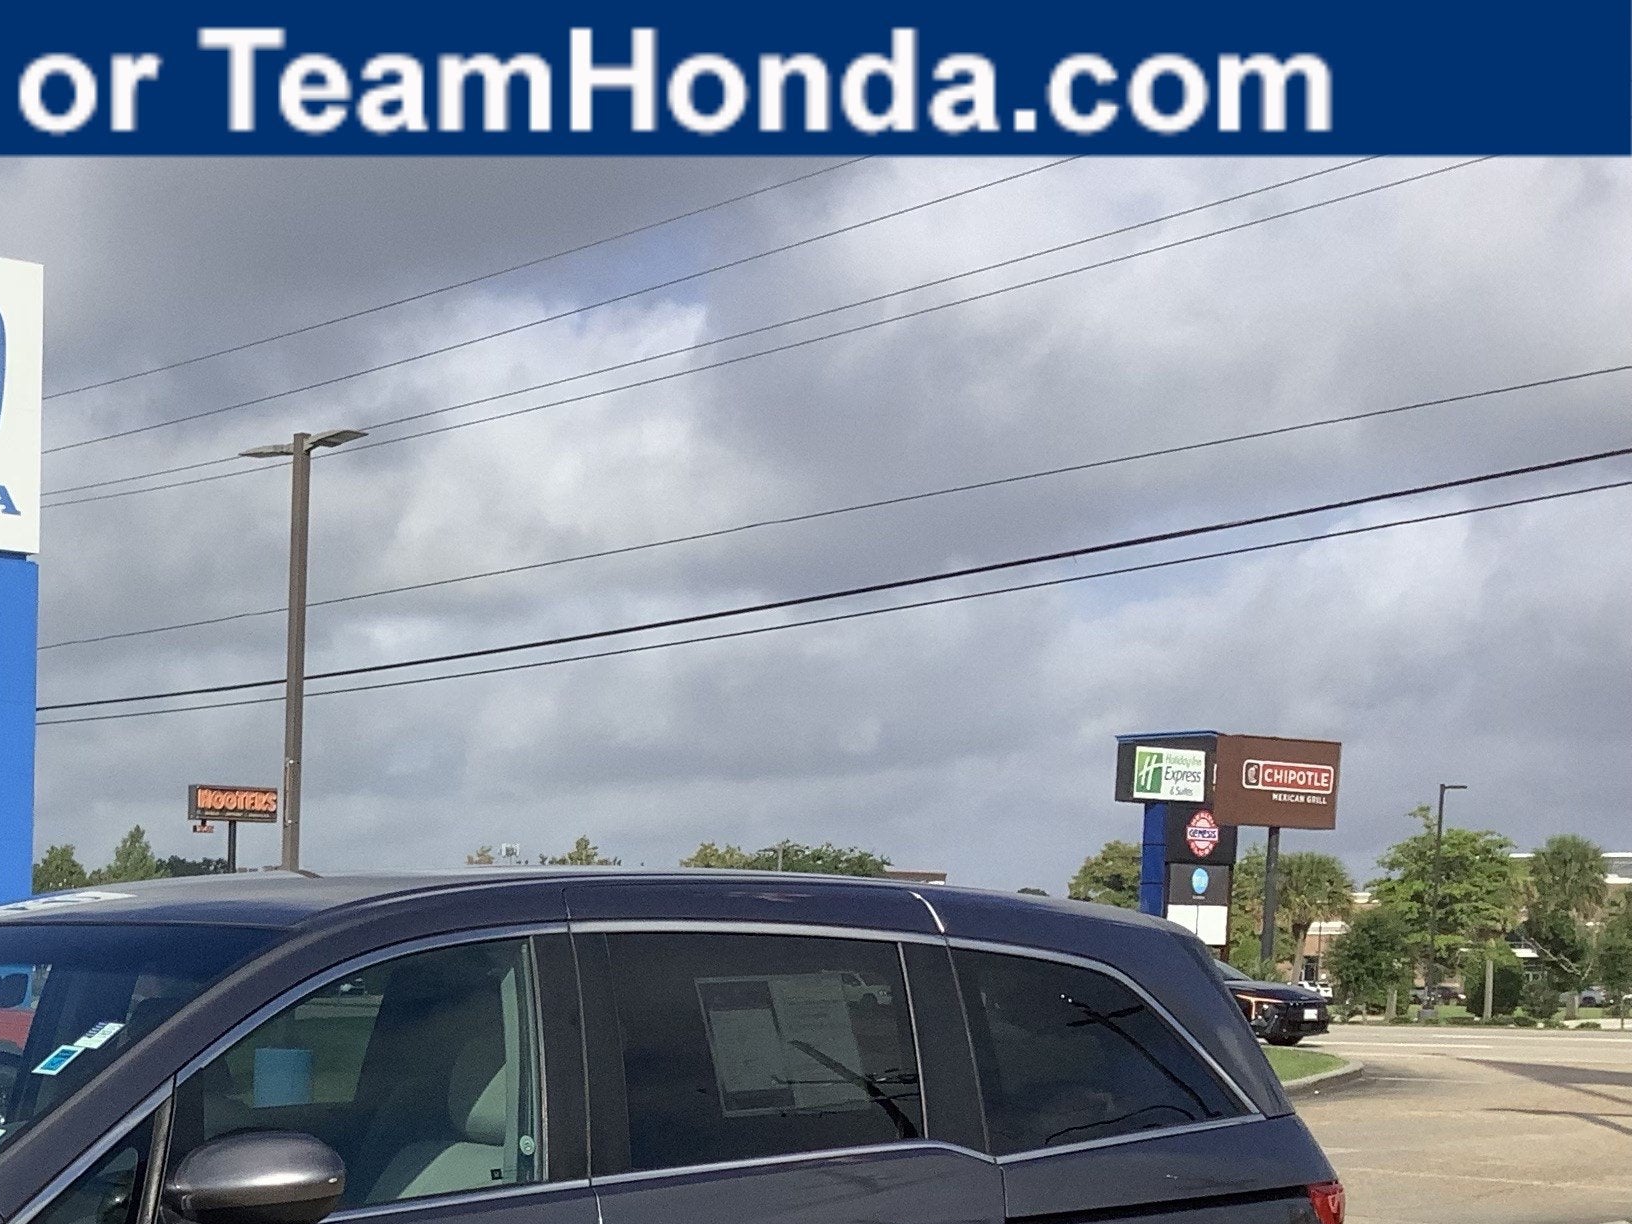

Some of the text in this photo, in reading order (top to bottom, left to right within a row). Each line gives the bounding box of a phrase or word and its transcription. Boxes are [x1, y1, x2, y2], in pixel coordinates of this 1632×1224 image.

[1164, 766, 1202, 785] Express
[1264, 768, 1330, 787] CHIPOTLE
[1175, 786, 1194, 796] Suites
[197, 788, 277, 812] HOOTERS
[1272, 793, 1328, 805] MEXICAN GRILL
[1188, 828, 1217, 839] GENESIS
